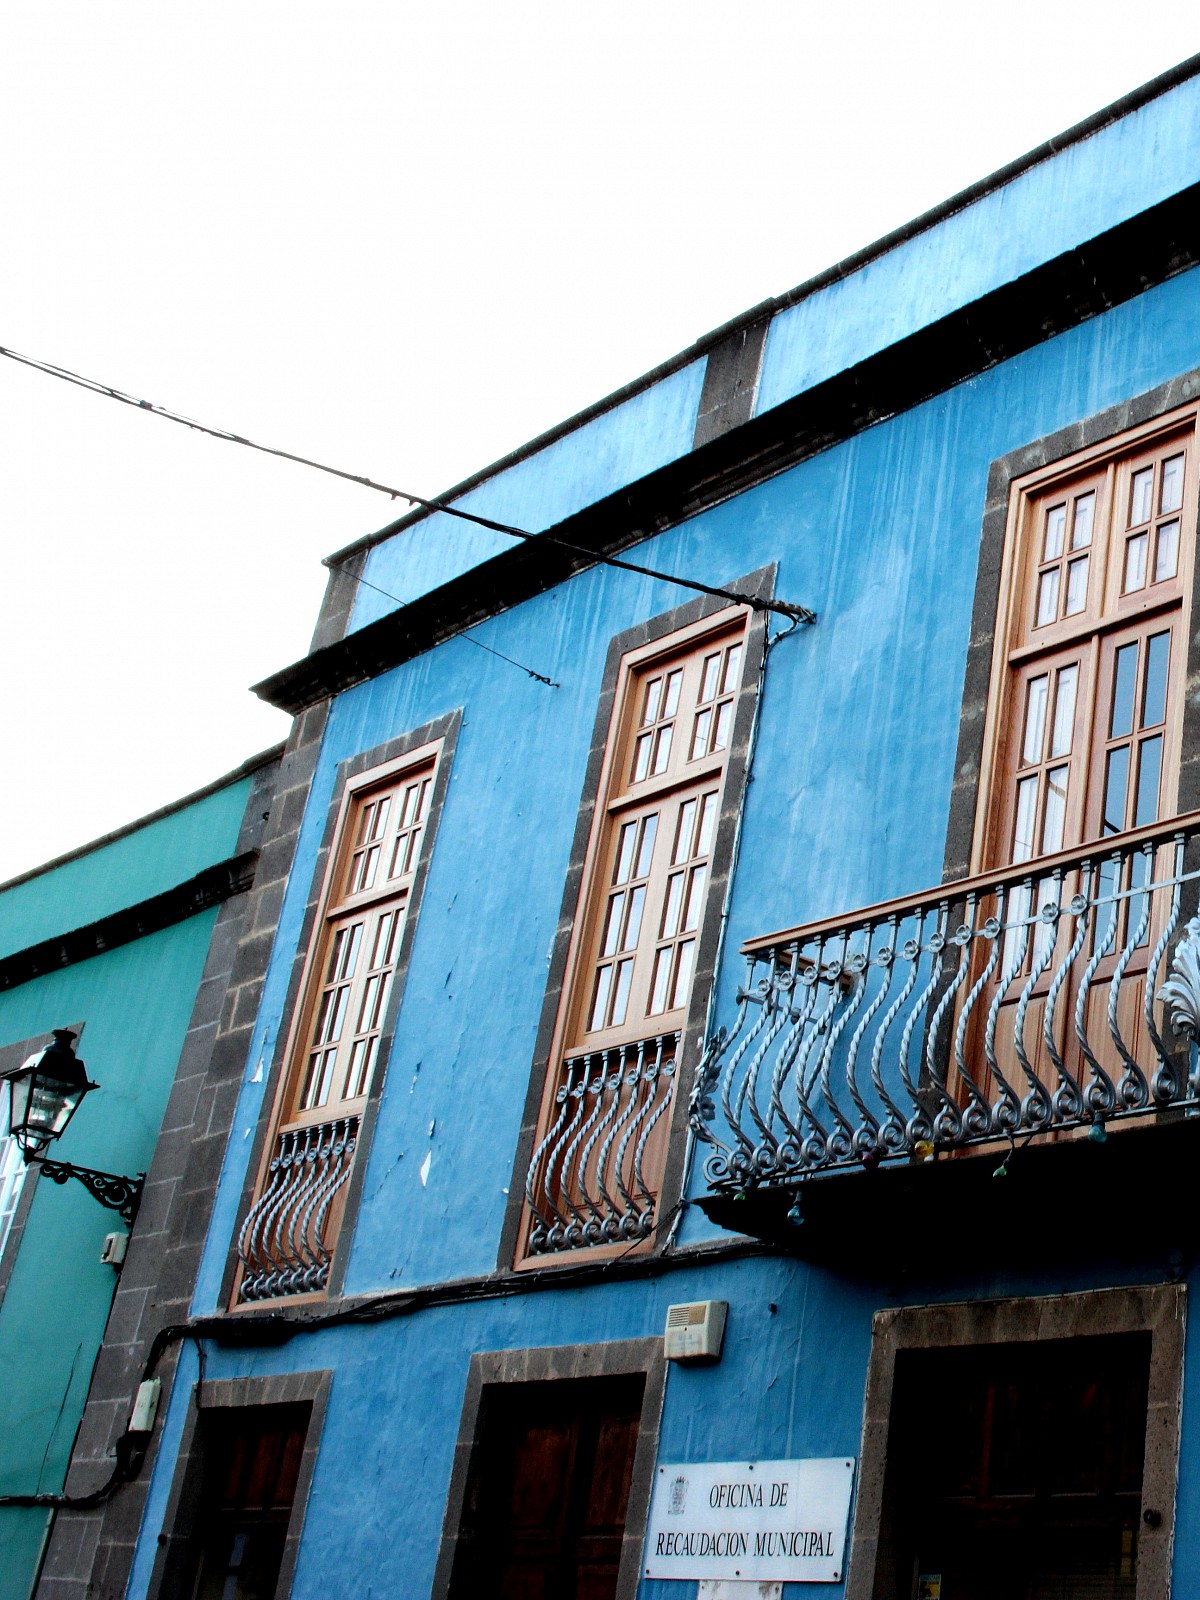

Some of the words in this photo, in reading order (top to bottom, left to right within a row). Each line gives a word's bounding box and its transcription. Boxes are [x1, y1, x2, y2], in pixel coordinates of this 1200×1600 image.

[709, 1484, 763, 1508] OFICINA
[769, 1482, 789, 1507] DE
[655, 1532, 749, 1557] RECAUDACION
[753, 1531, 834, 1557] MUNICIPAL
